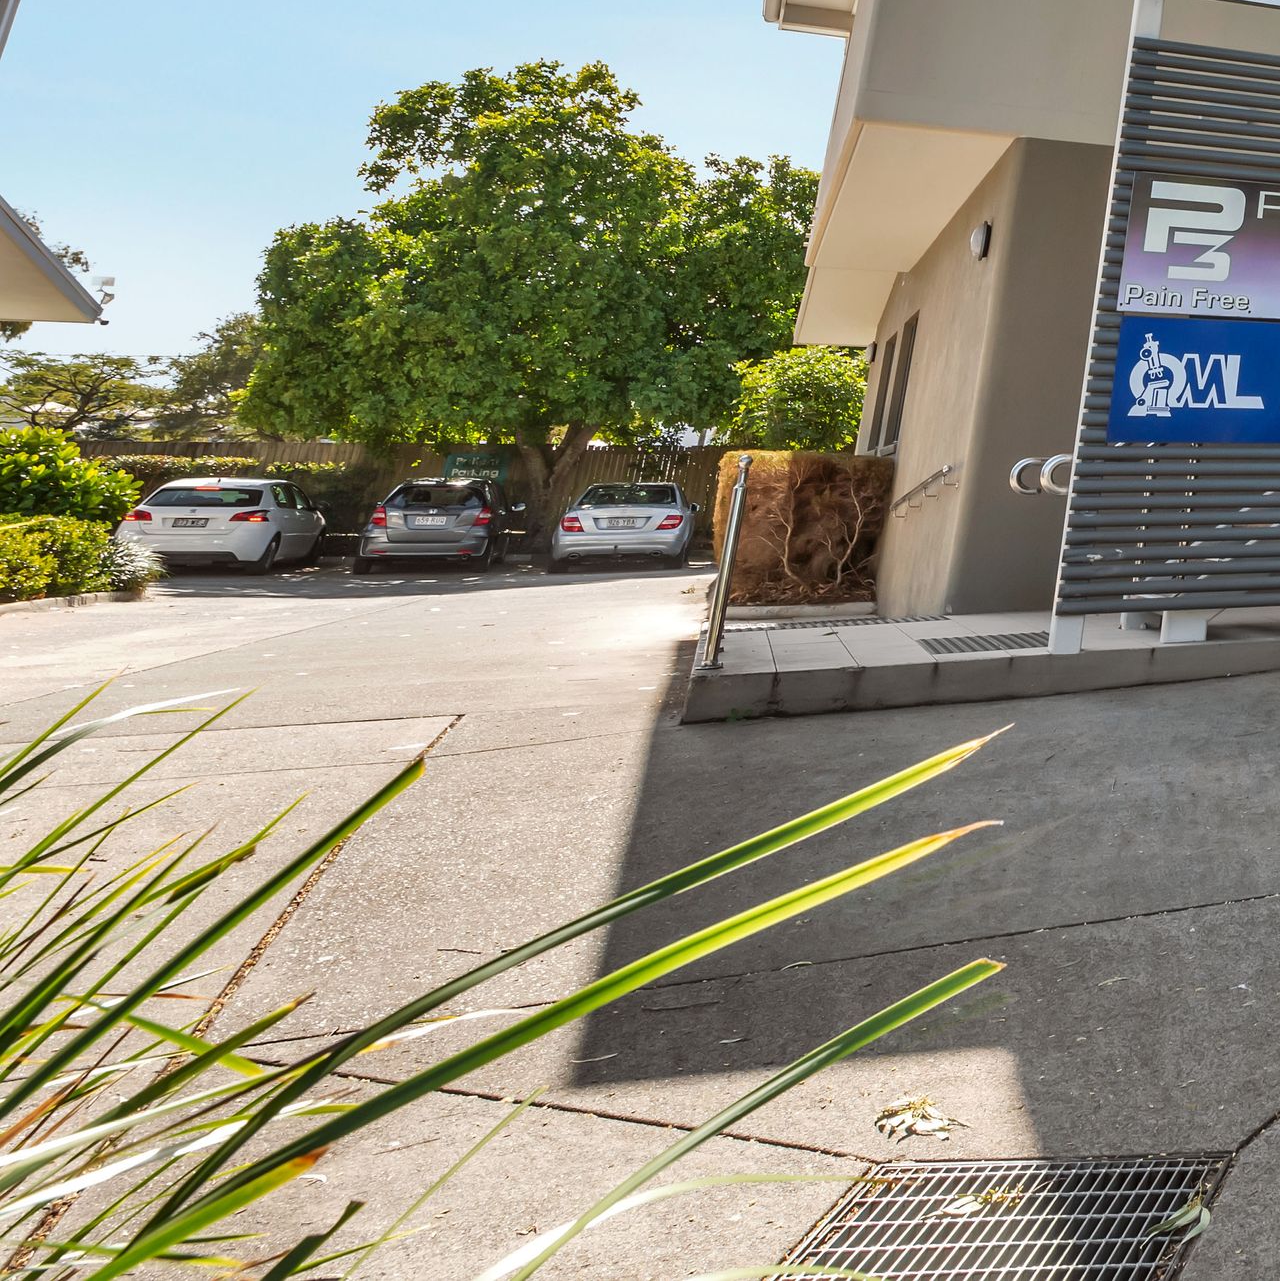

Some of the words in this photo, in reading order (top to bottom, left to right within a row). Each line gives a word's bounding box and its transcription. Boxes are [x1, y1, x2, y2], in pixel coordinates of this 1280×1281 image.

[1124, 284, 1183, 308] Pain
[1191, 287, 1251, 311] Free
[451, 468, 499, 479] Parking
